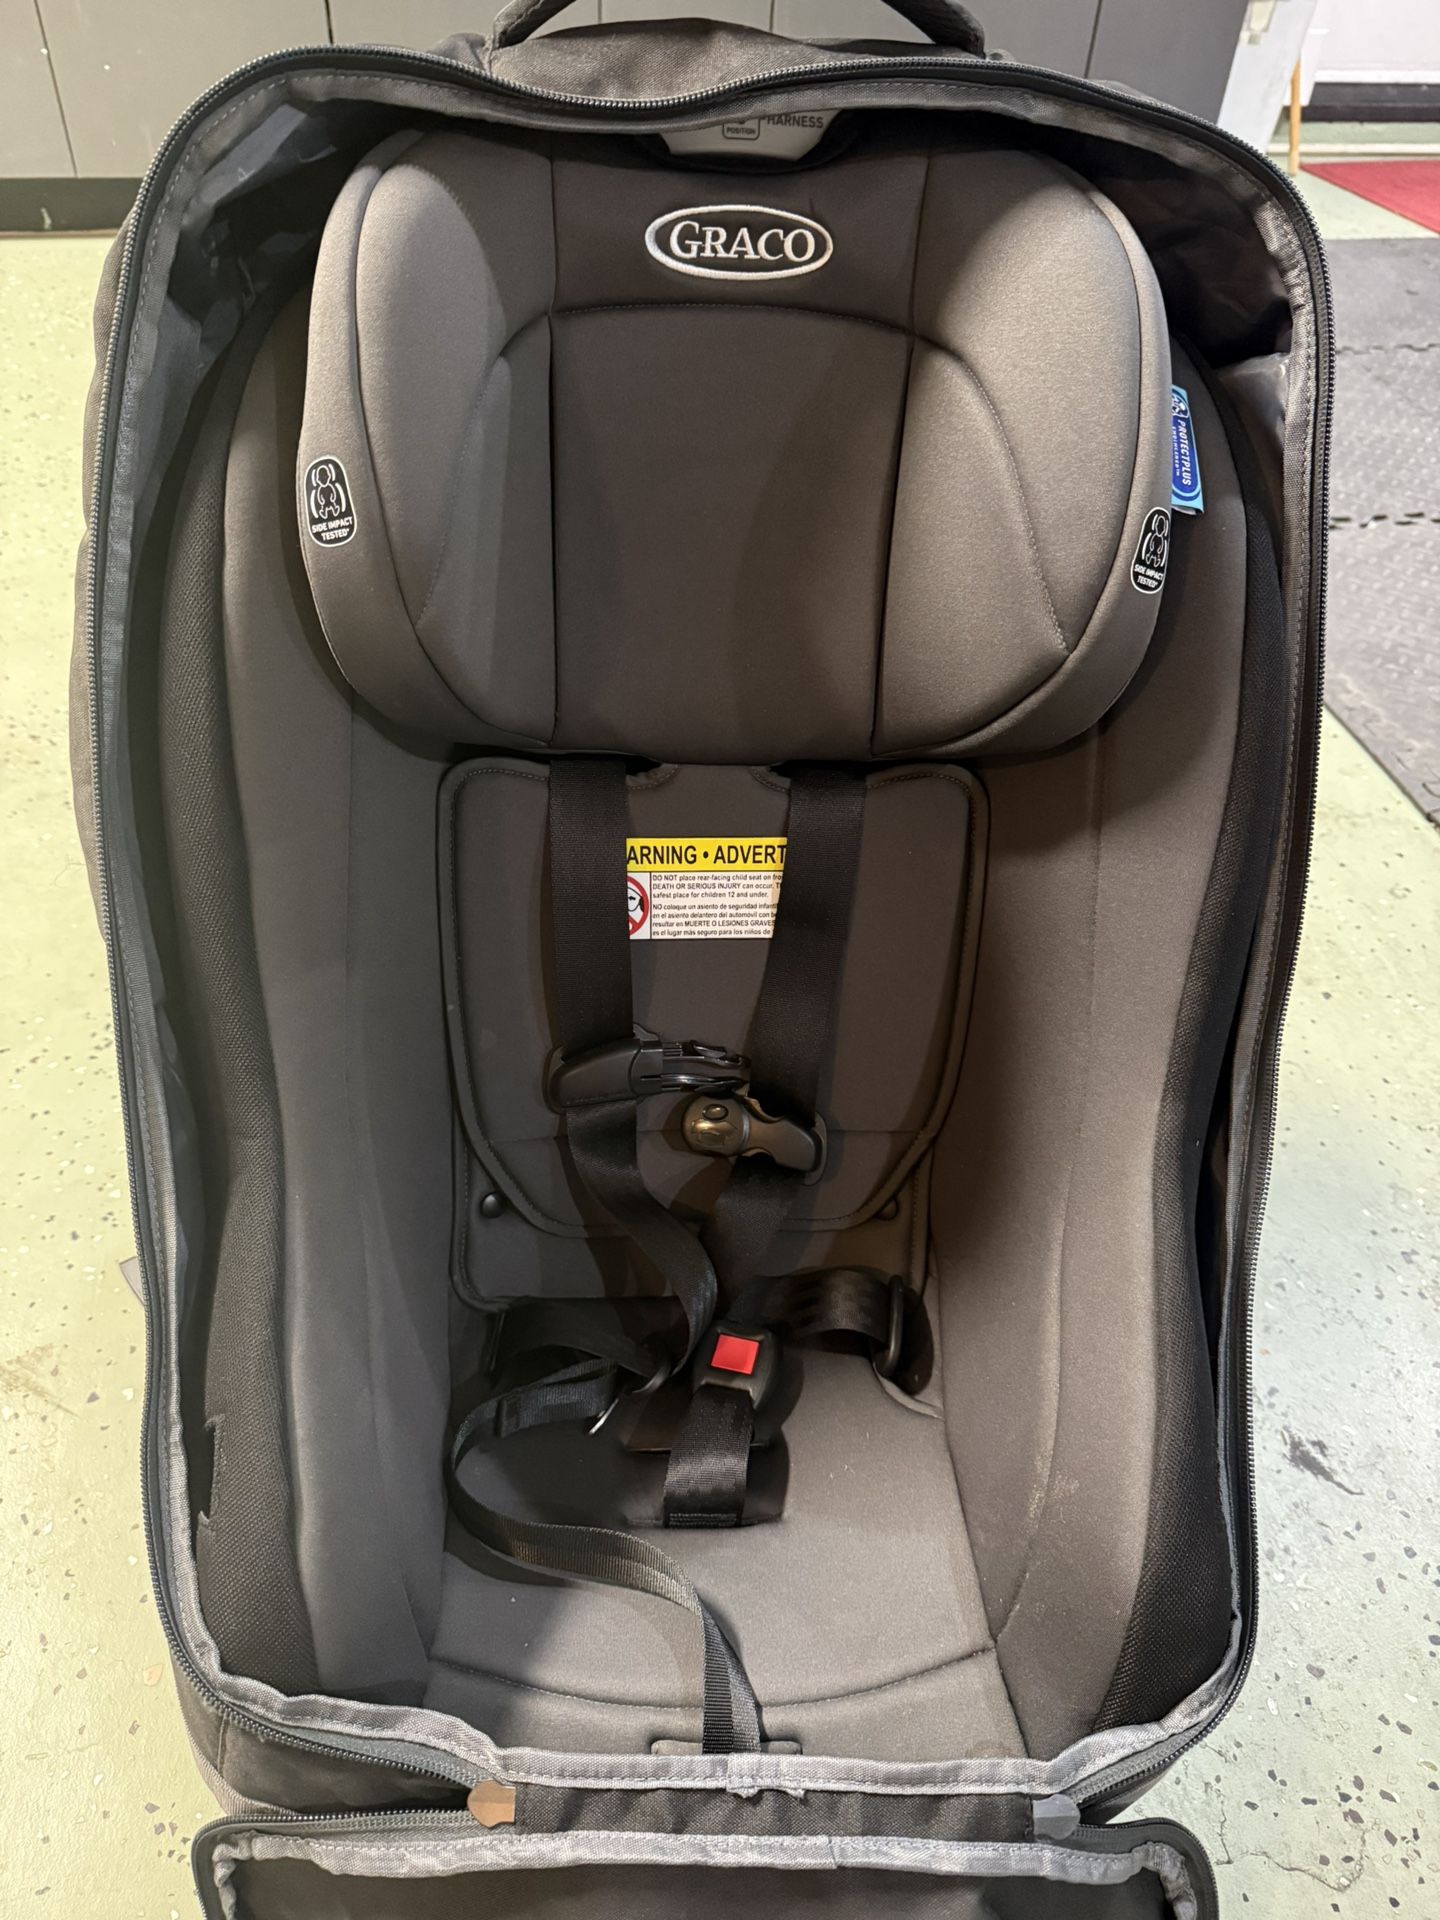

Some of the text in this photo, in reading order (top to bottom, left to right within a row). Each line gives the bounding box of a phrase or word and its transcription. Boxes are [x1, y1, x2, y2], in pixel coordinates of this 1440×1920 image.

[670, 220, 815, 262] GRACO
[311, 517, 353, 534] SIDE IMPACT
[1134, 563, 1164, 581] SIDE IMPACT
[627, 845, 697, 864] ARNING
[698, 874, 731, 882] rear-facing
[728, 903, 758, 911] seguridad
[667, 929, 682, 937] lugar
